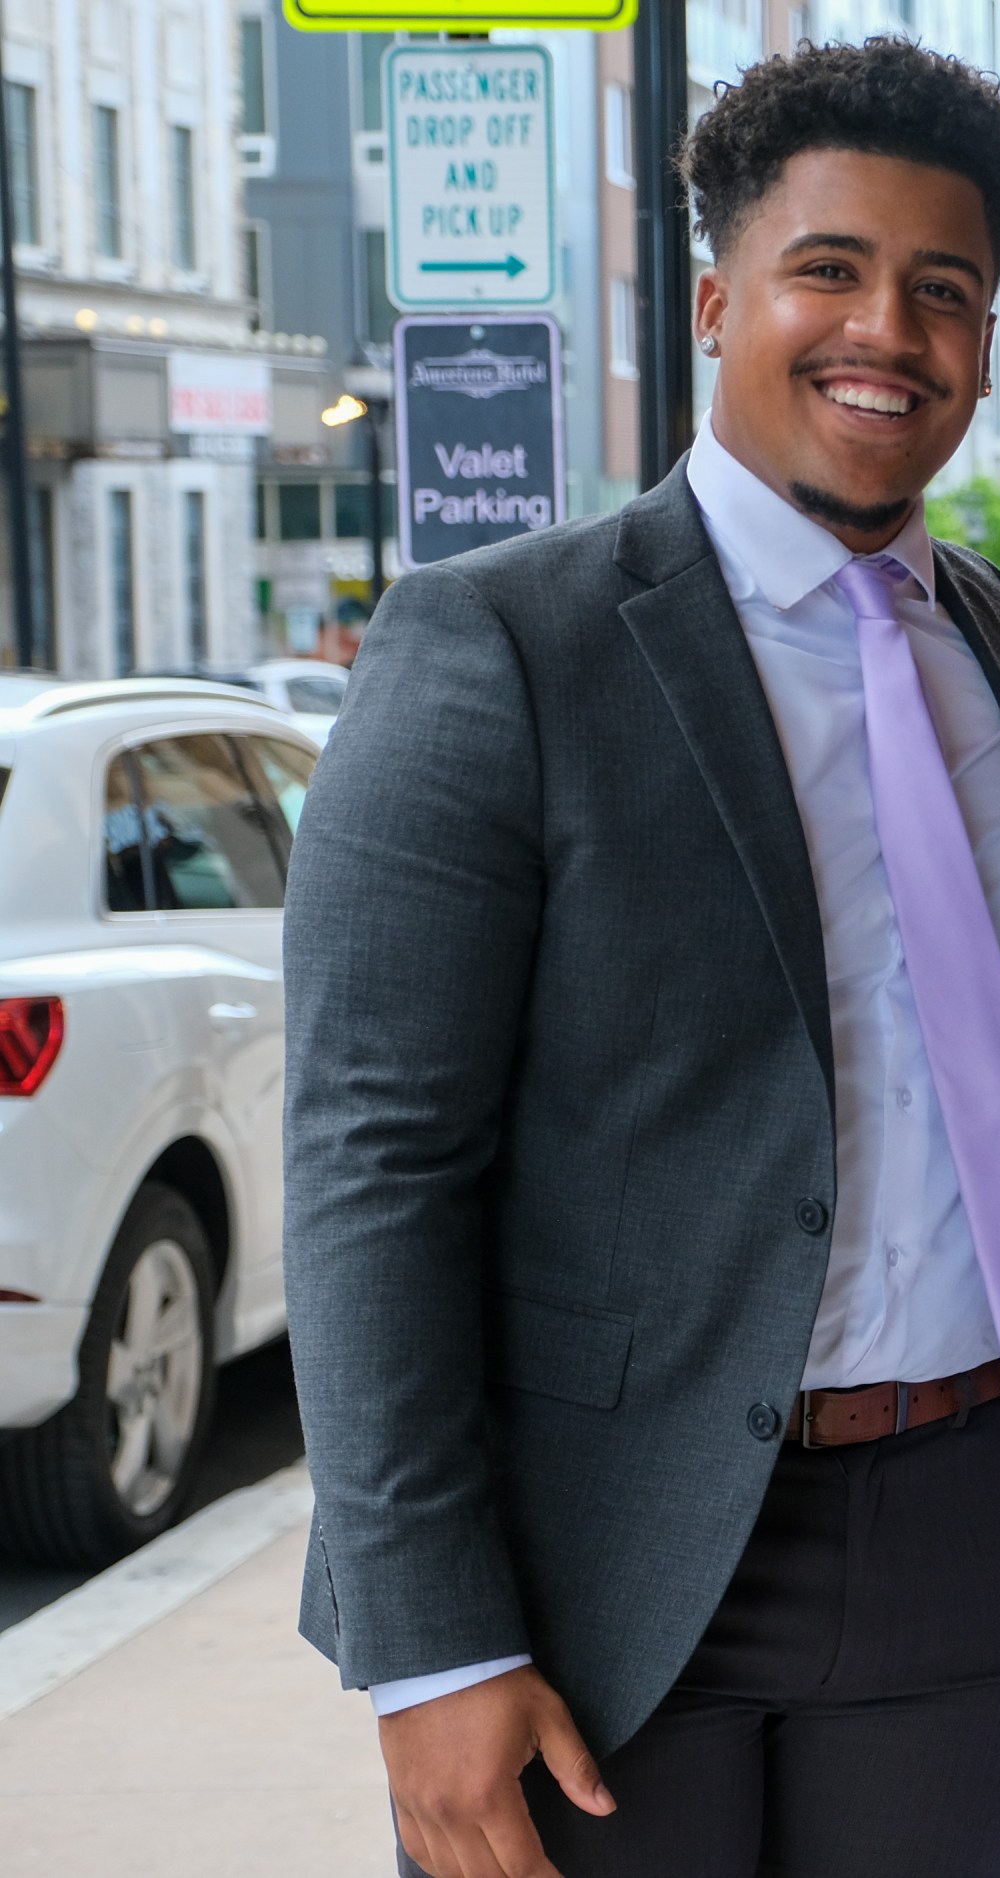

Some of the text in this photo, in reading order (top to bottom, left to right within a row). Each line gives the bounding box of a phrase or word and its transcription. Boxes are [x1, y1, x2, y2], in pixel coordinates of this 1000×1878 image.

[399, 69, 539, 103] PASSENGER
[407, 114, 533, 148] DROP OFF
[445, 159, 498, 191] AND
[422, 204, 524, 237] PICK UP
[434, 442, 528, 479] Valet
[413, 488, 551, 530] Parking
